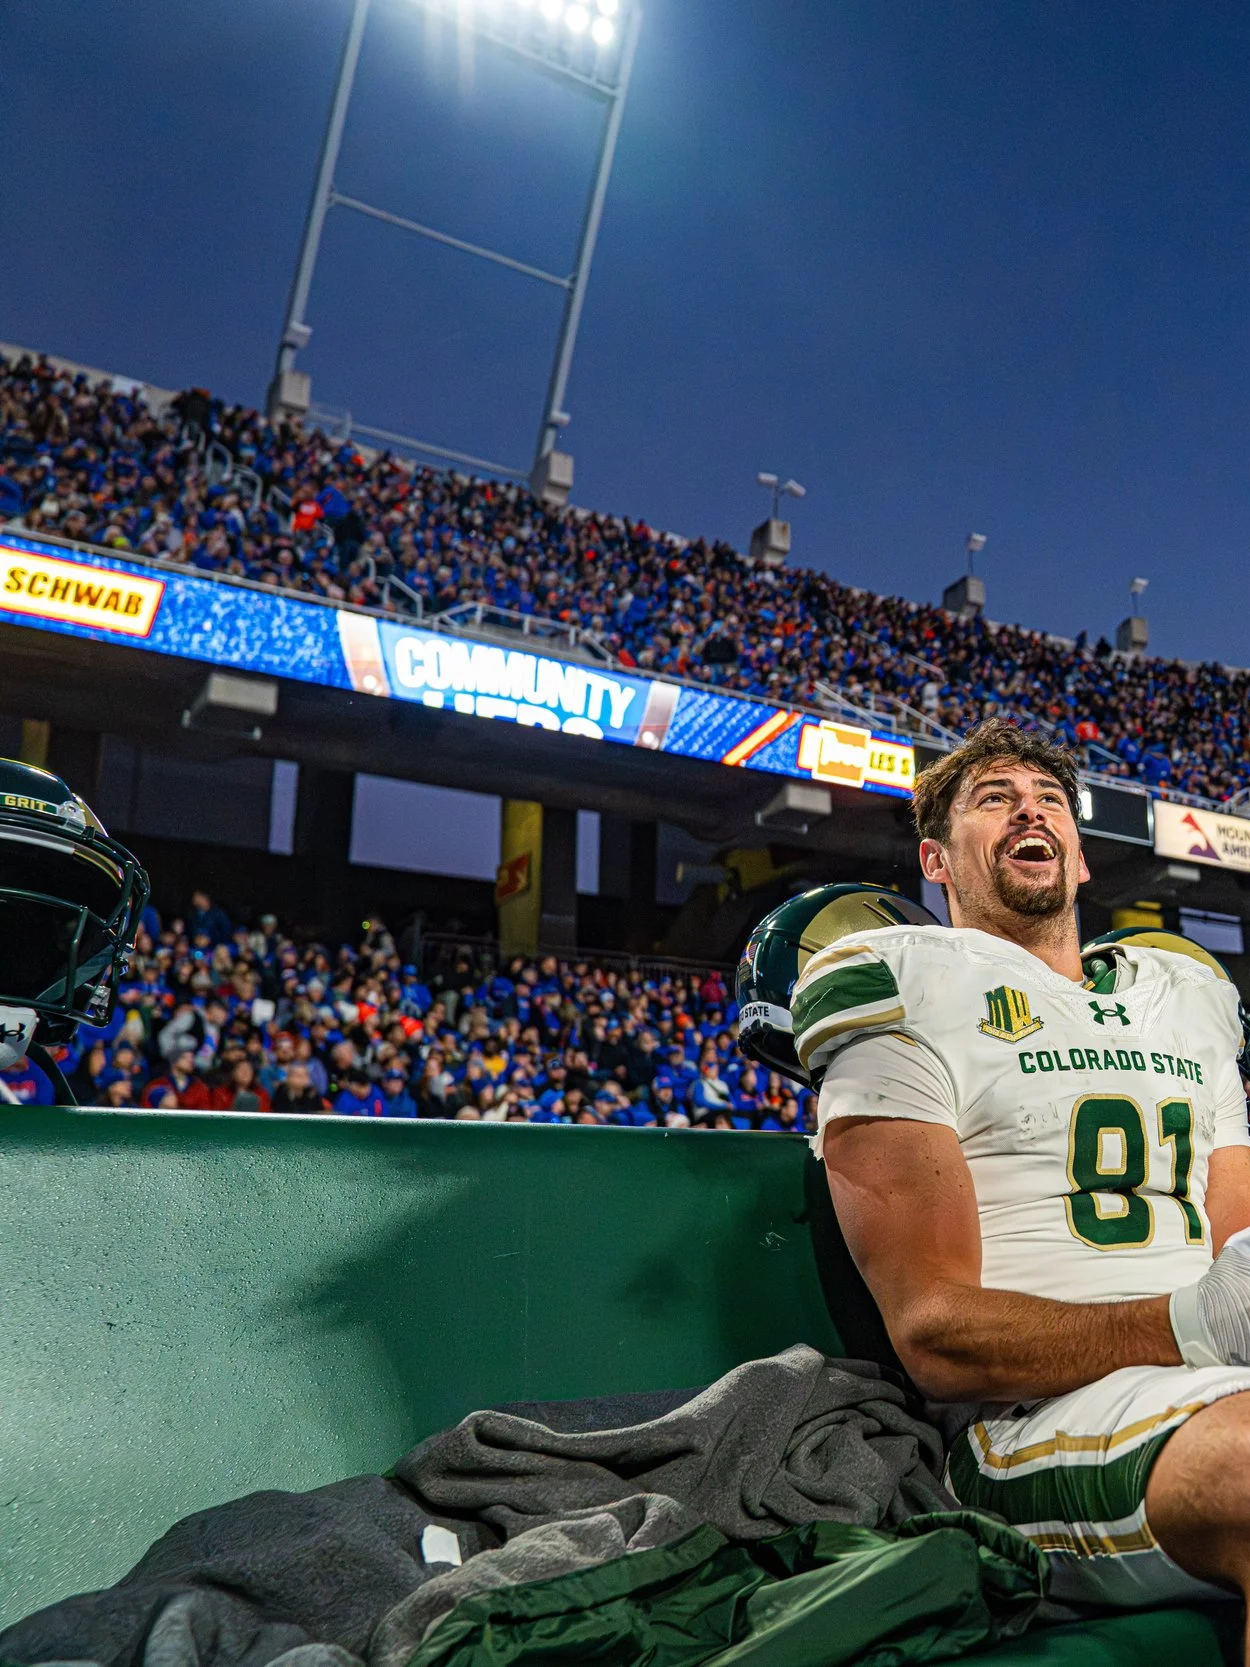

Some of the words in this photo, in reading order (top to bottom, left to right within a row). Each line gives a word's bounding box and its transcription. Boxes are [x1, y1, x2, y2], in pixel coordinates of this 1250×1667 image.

[4, 567, 144, 617] SCHWAB
[394, 636, 637, 730] COMMUNITY
[868, 750, 896, 773] LES
[4, 795, 47, 811] GRIT
[744, 1005, 770, 1019] STATE
[984, 984, 1032, 1034] MW
[1018, 1048, 1147, 1074] COLORADO
[1150, 1052, 1204, 1086] STATE
[1064, 1092, 1205, 1252] 81
